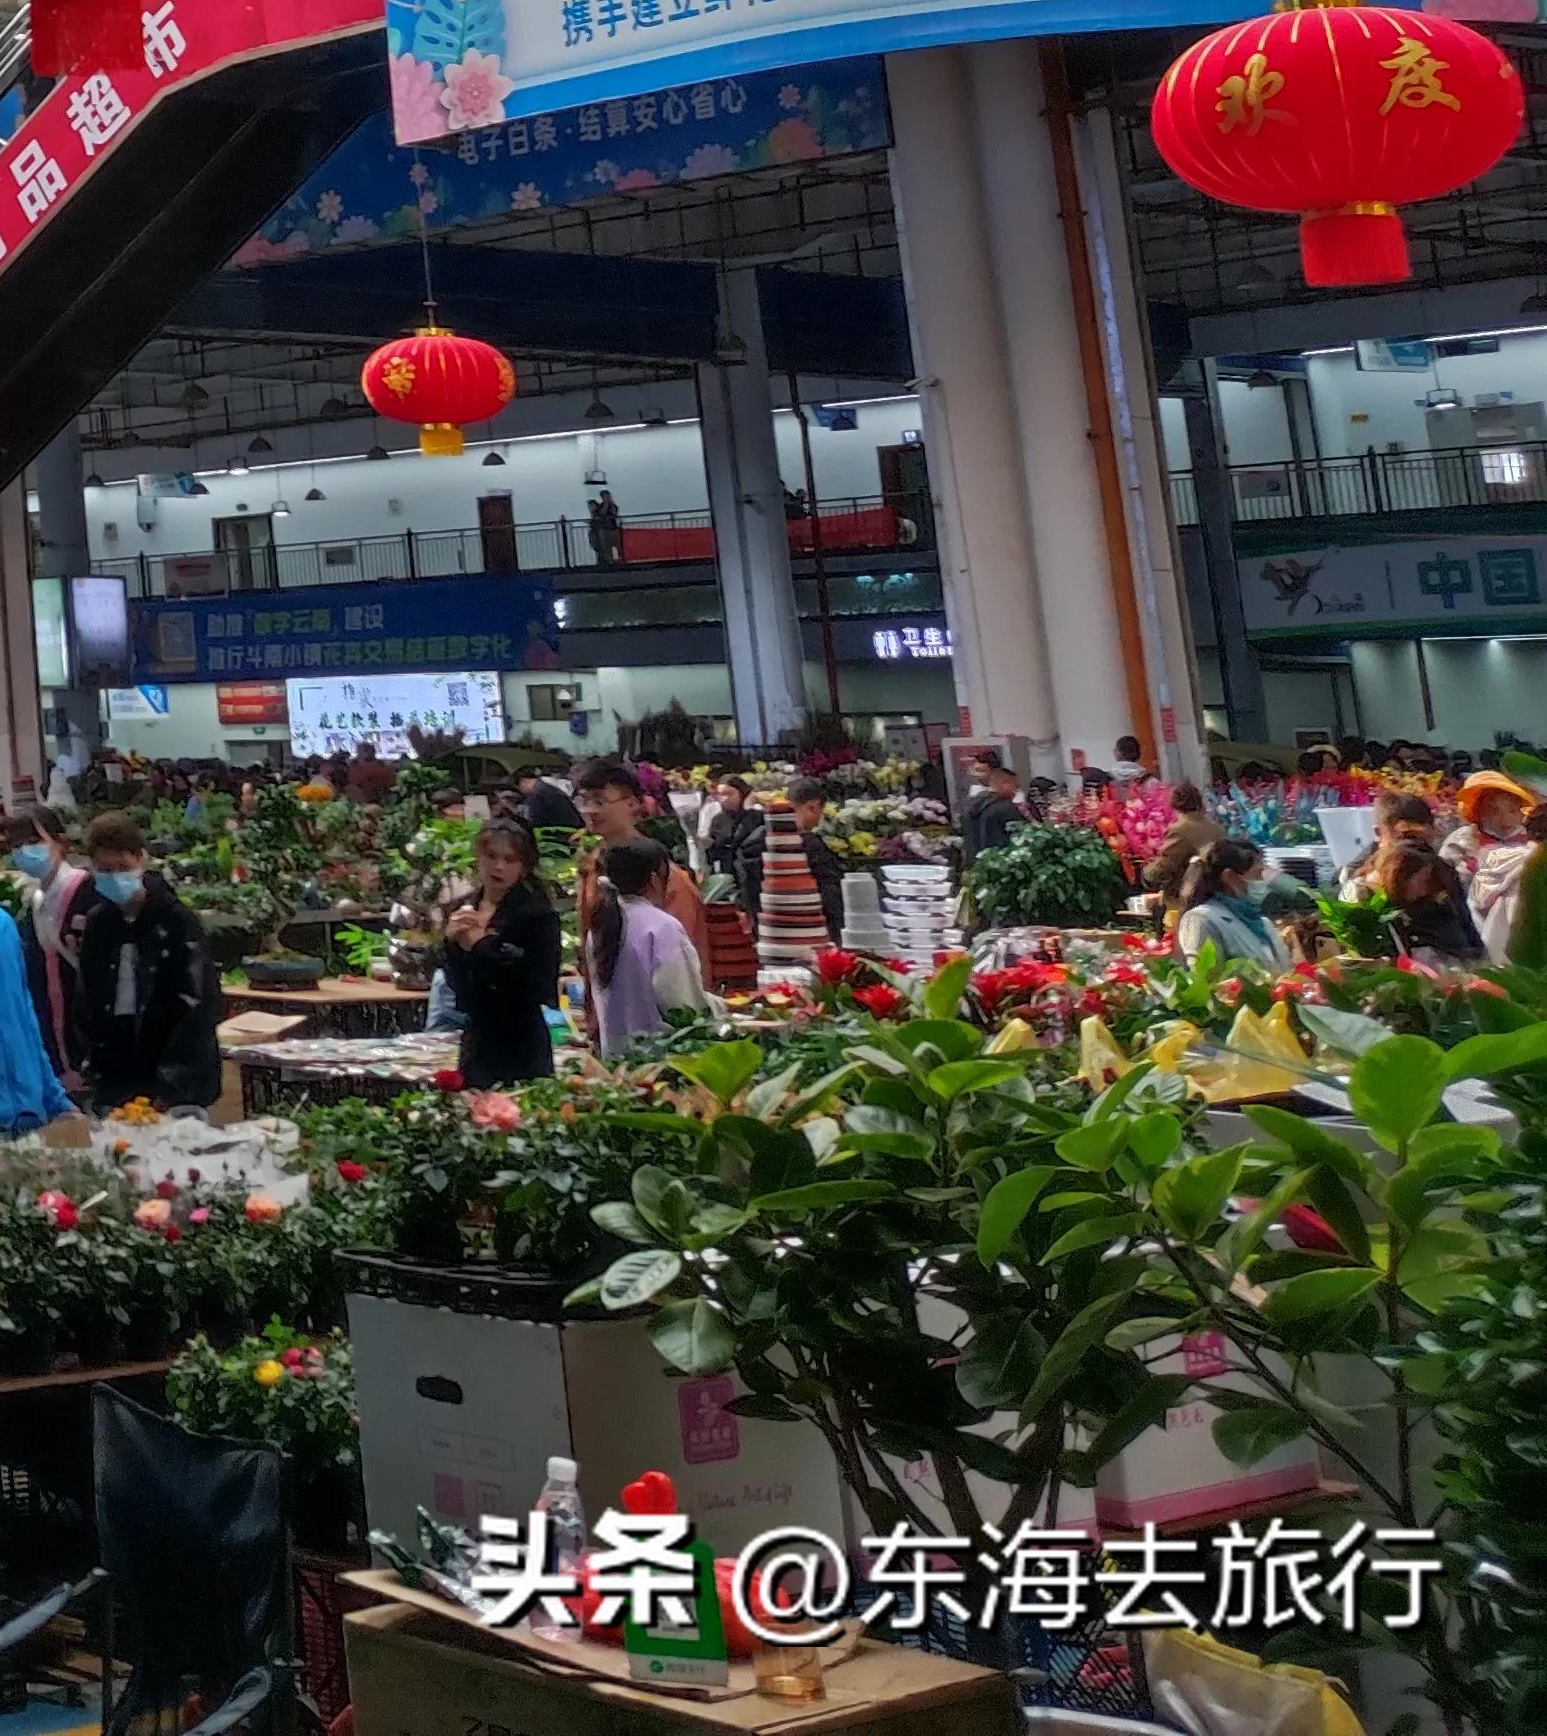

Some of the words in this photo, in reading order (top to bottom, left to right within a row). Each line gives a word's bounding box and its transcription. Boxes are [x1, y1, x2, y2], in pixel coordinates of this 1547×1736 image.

[1214, 36, 1462, 138] 欢度
[1416, 547, 1542, 610] 中国
[901, 626, 952, 646] 卫生
